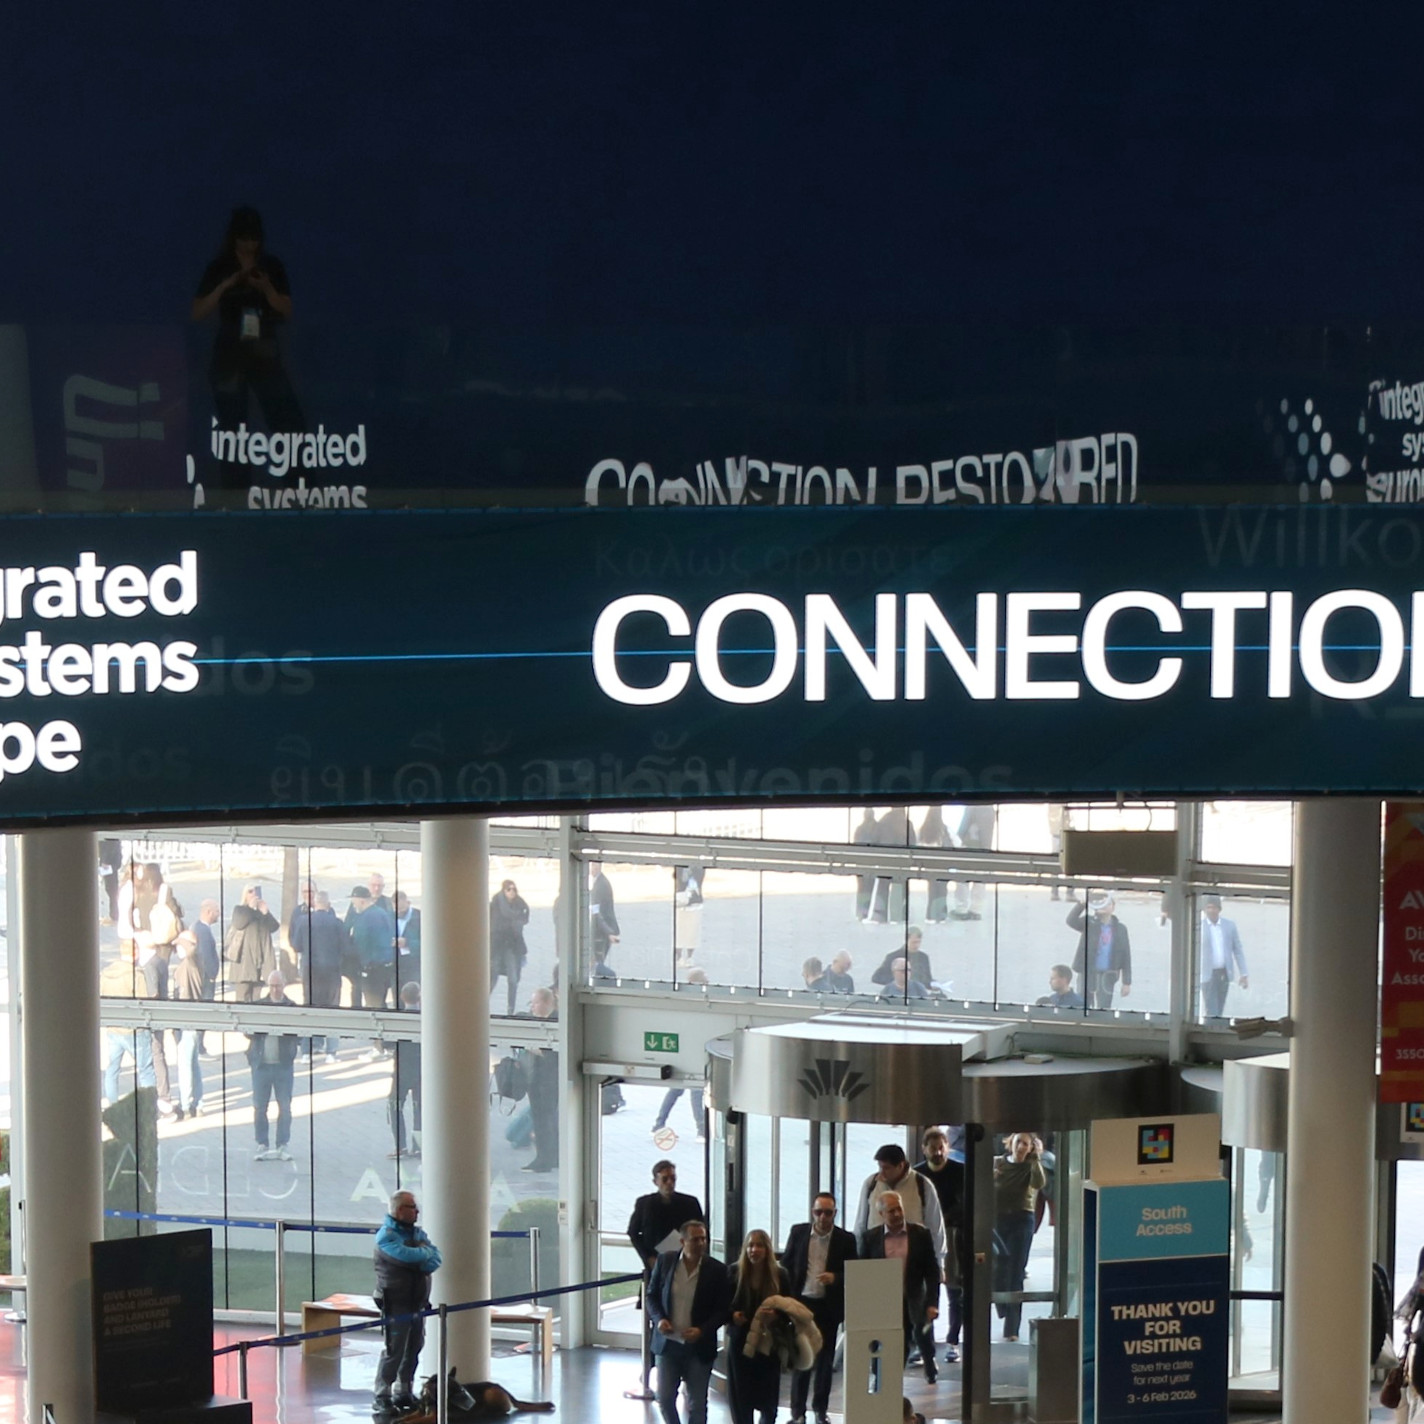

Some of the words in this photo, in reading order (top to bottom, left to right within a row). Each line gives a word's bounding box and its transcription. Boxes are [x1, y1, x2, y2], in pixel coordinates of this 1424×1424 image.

[212, 416, 367, 477] integrated
[1141, 1204, 1187, 1221] South
[1136, 1222, 1192, 1237] Access
[1111, 1301, 1174, 1320] THANK
[1177, 1299, 1215, 1316] YOU
[1144, 1319, 1181, 1336] FOR
[1123, 1336, 1202, 1355] VISITING
[1130, 1362, 1154, 1373] Save
[1155, 1361, 1171, 1371] the
[1172, 1360, 1194, 1370] date
[1133, 1374, 1146, 1385] for
[1147, 1375, 1168, 1385] next
[1169, 1373, 1191, 1385] year
[1127, 1393, 1135, 1404] 3
[1142, 1392, 1150, 1403] 6
[1151, 1390, 1169, 1402] Feb
[1170, 1390, 1197, 1401] 2026
